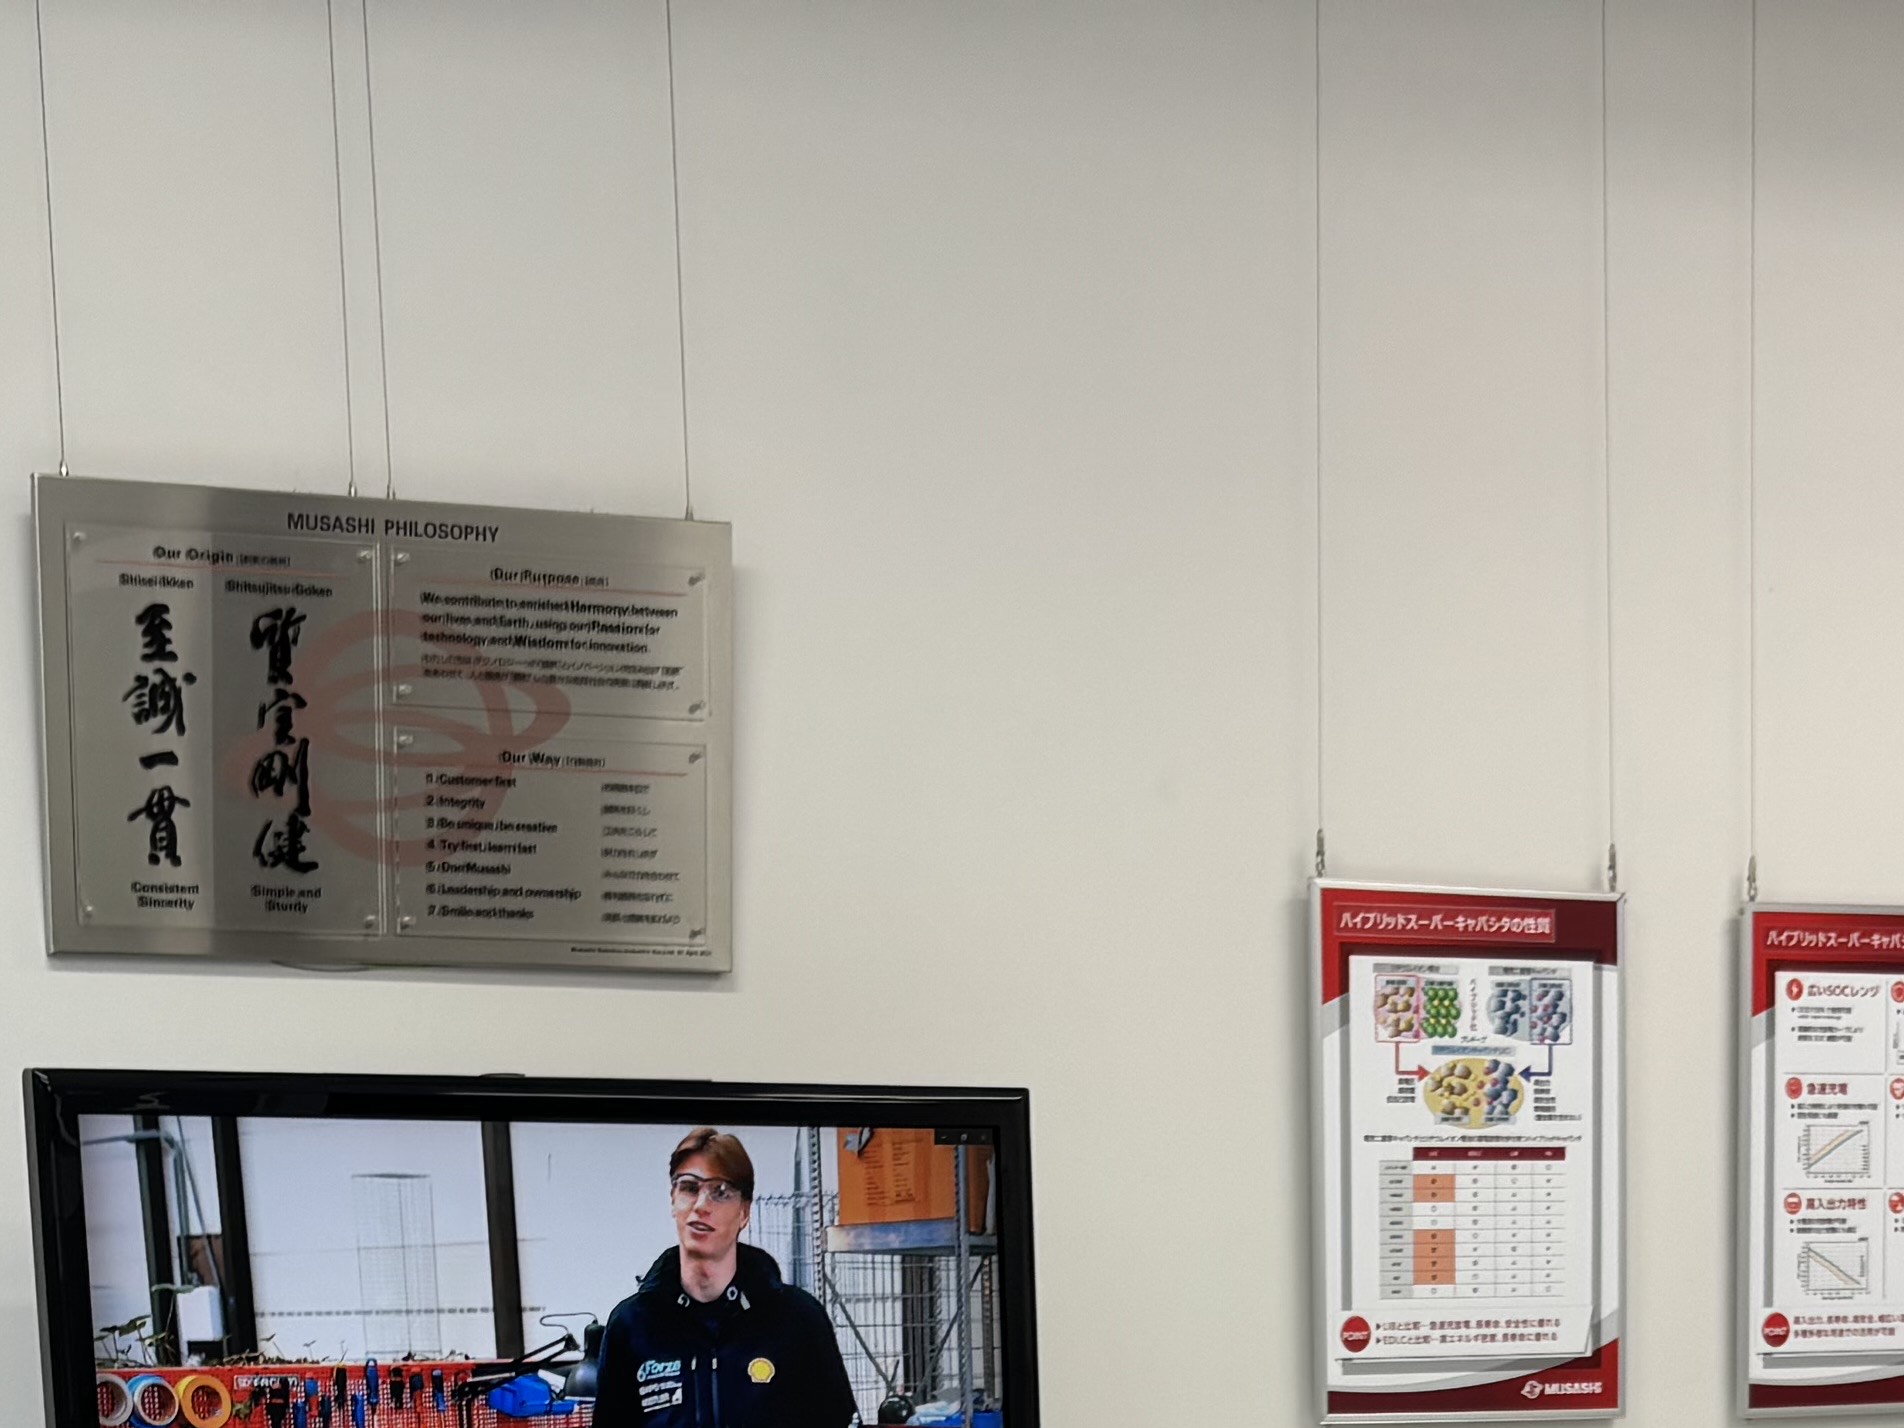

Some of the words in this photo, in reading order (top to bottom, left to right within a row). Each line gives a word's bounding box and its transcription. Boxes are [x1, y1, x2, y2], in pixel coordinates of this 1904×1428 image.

[287, 513, 376, 535] MUSASHI
[384, 519, 500, 543] PHILOSOPHY
[153, 545, 181, 560] Our
[185, 547, 234, 565] Origin
[490, 567, 518, 582] Our
[520, 569, 580, 586] Purpose
[499, 751, 526, 765] Our
[528, 752, 561, 768] Way
